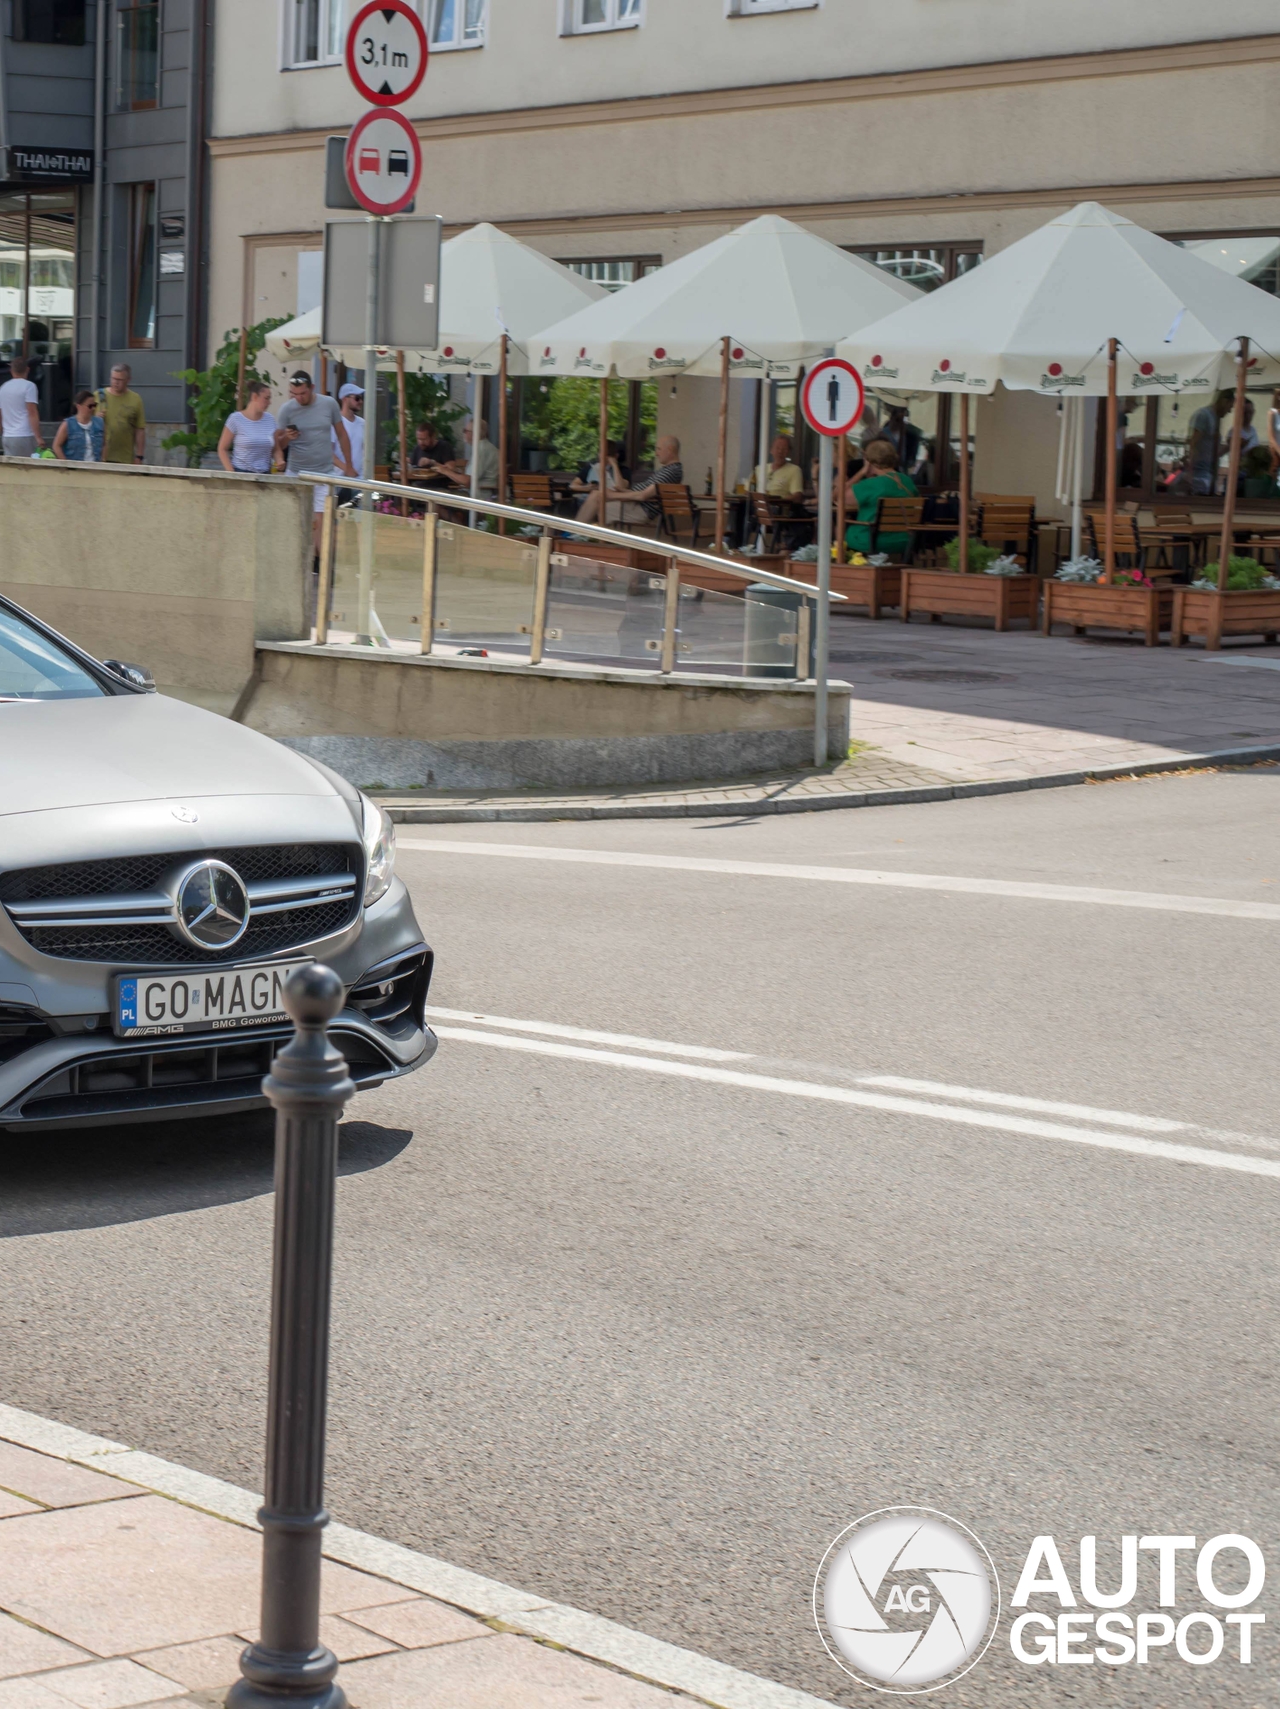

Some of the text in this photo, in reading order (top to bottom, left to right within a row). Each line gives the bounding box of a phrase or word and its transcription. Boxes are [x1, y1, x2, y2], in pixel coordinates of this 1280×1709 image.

[361, 37, 409, 68] 3,1 m
[14, 152, 91, 171] THAI THAI
[145, 969, 290, 1021] GO MAGN
[122, 1009, 135, 1020] PL
[212, 1013, 292, 1029] BMG Goworows
